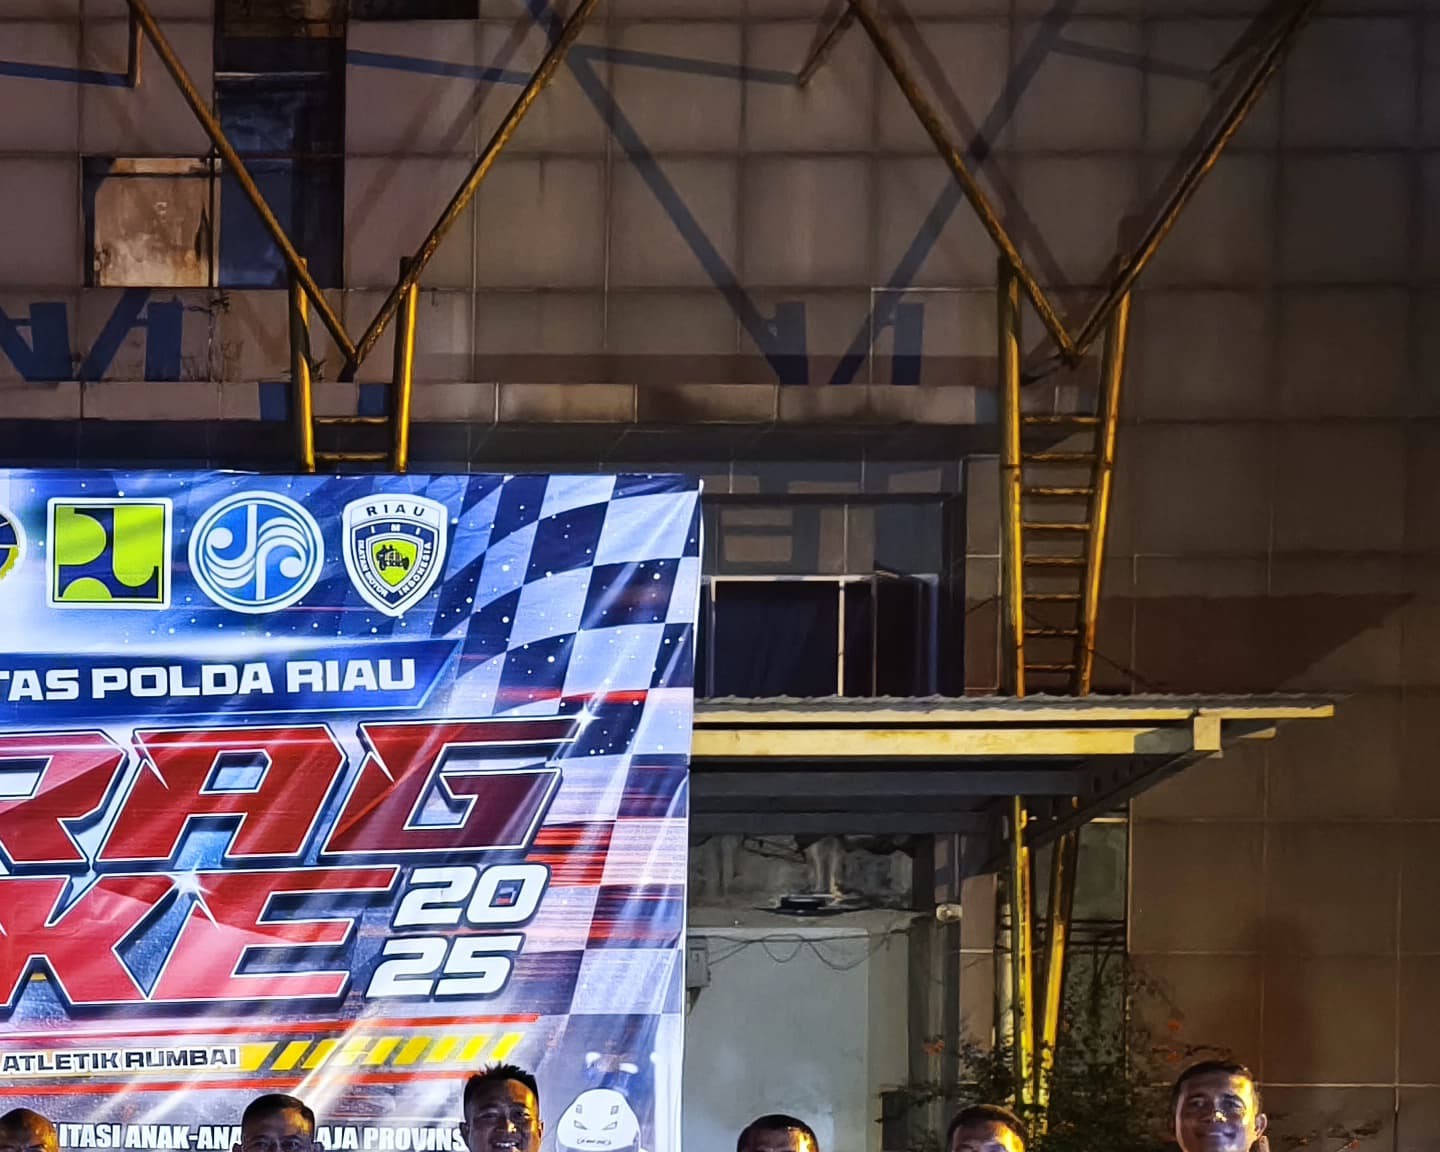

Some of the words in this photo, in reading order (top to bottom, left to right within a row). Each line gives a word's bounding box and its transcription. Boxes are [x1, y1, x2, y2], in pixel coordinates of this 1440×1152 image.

[366, 504, 425, 516] RIAU
[92, 663, 275, 699] POLDA
[286, 657, 416, 692] RIAU
[2, 1050, 120, 1072] ATLETIK
[125, 1047, 238, 1068] RUMBAI
